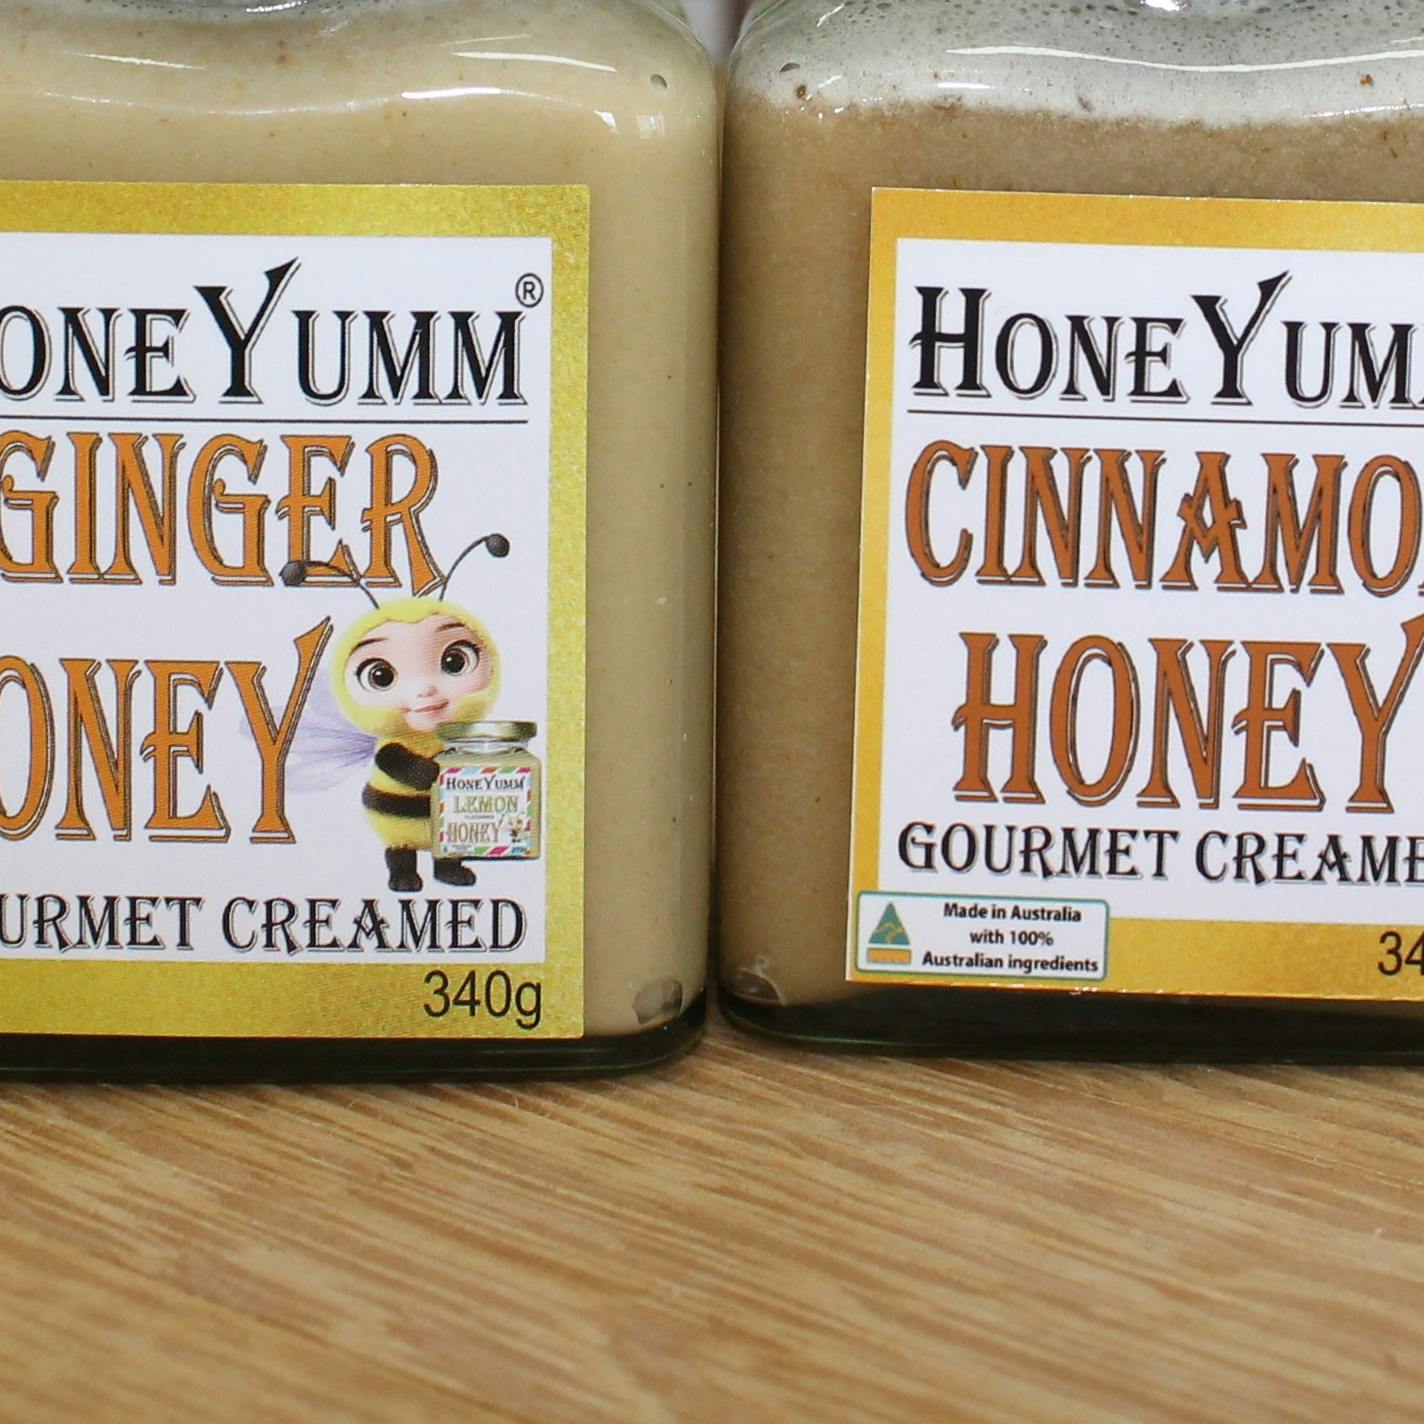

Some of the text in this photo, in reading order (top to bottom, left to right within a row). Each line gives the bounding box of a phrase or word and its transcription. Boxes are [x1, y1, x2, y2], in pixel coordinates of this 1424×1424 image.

[454, 795, 518, 813] LEMON
[446, 814, 504, 843] HONEY
[898, 822, 1180, 880] GOURMET
[222, 895, 526, 955] CREAMED
[944, 902, 1082, 922] Made in Australia
[970, 929, 1053, 946] with 100%
[922, 951, 1098, 974] Australian ingredients
[423, 970, 543, 1027] 340g
